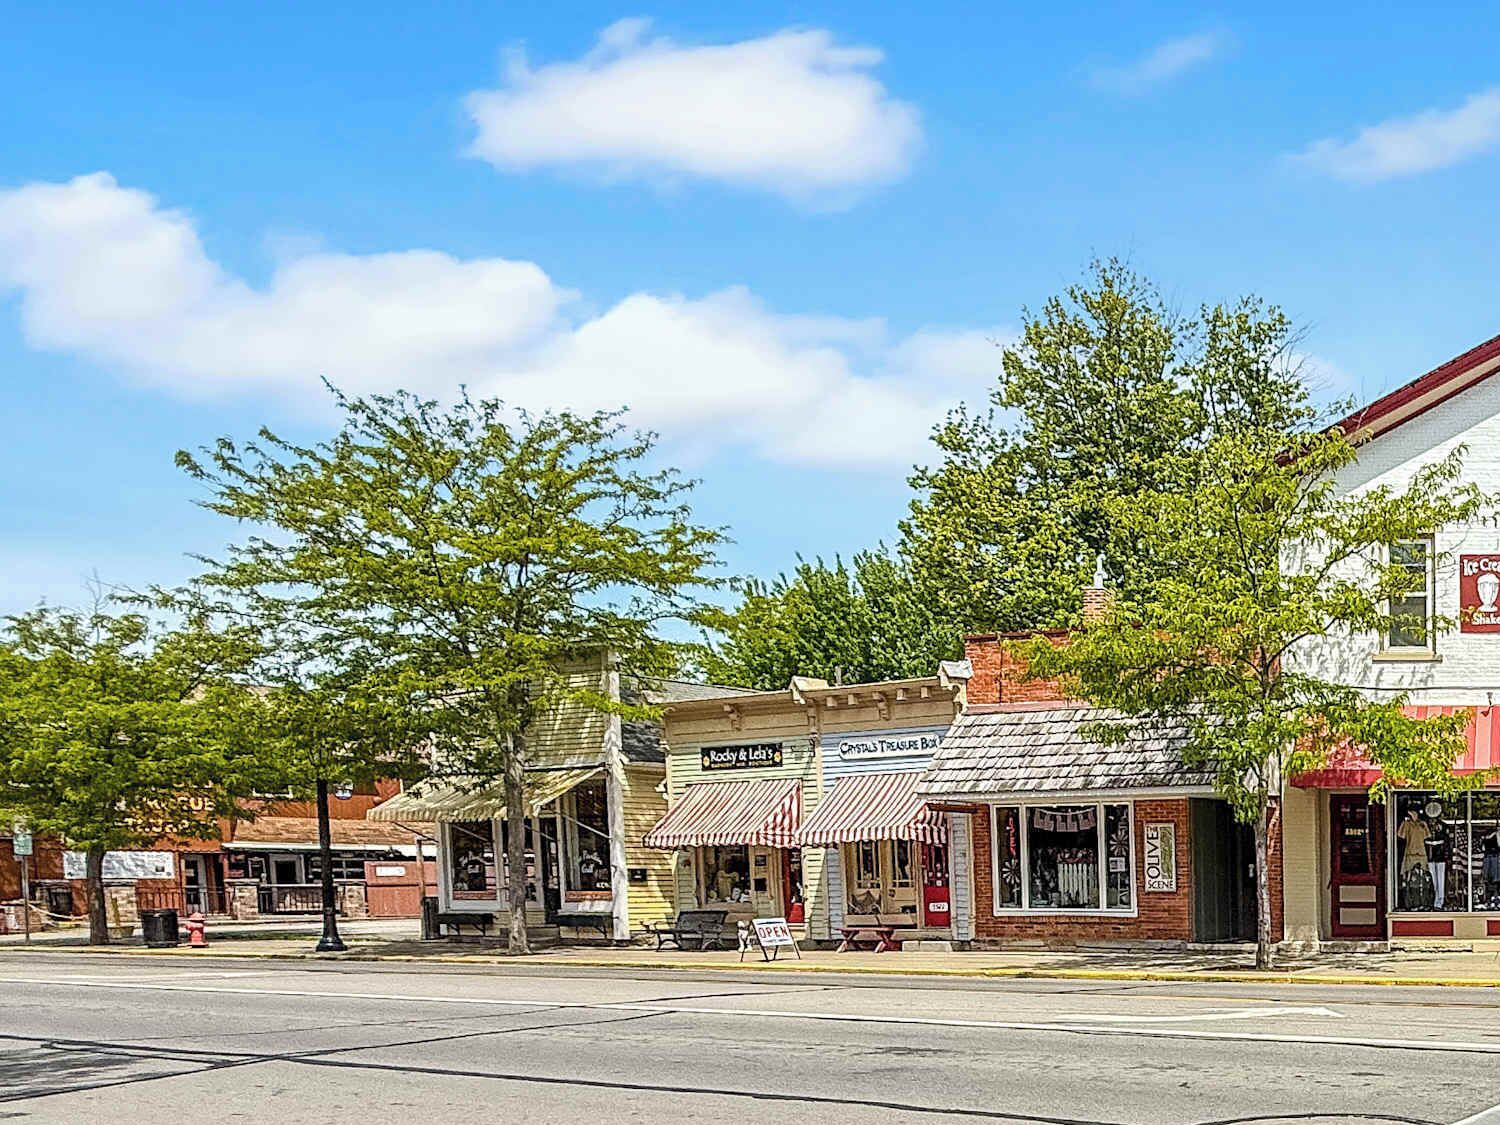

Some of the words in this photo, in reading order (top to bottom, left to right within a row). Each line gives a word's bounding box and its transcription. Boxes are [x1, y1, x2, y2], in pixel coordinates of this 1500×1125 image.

[1463, 559, 1479, 576] Ice
[710, 748, 737, 764] Rocky
[739, 748, 747, 761] &
[1146, 831, 1160, 879] OLIVE
[1148, 880, 1174, 889] SCENE
[758, 926, 789, 939] OPEN
